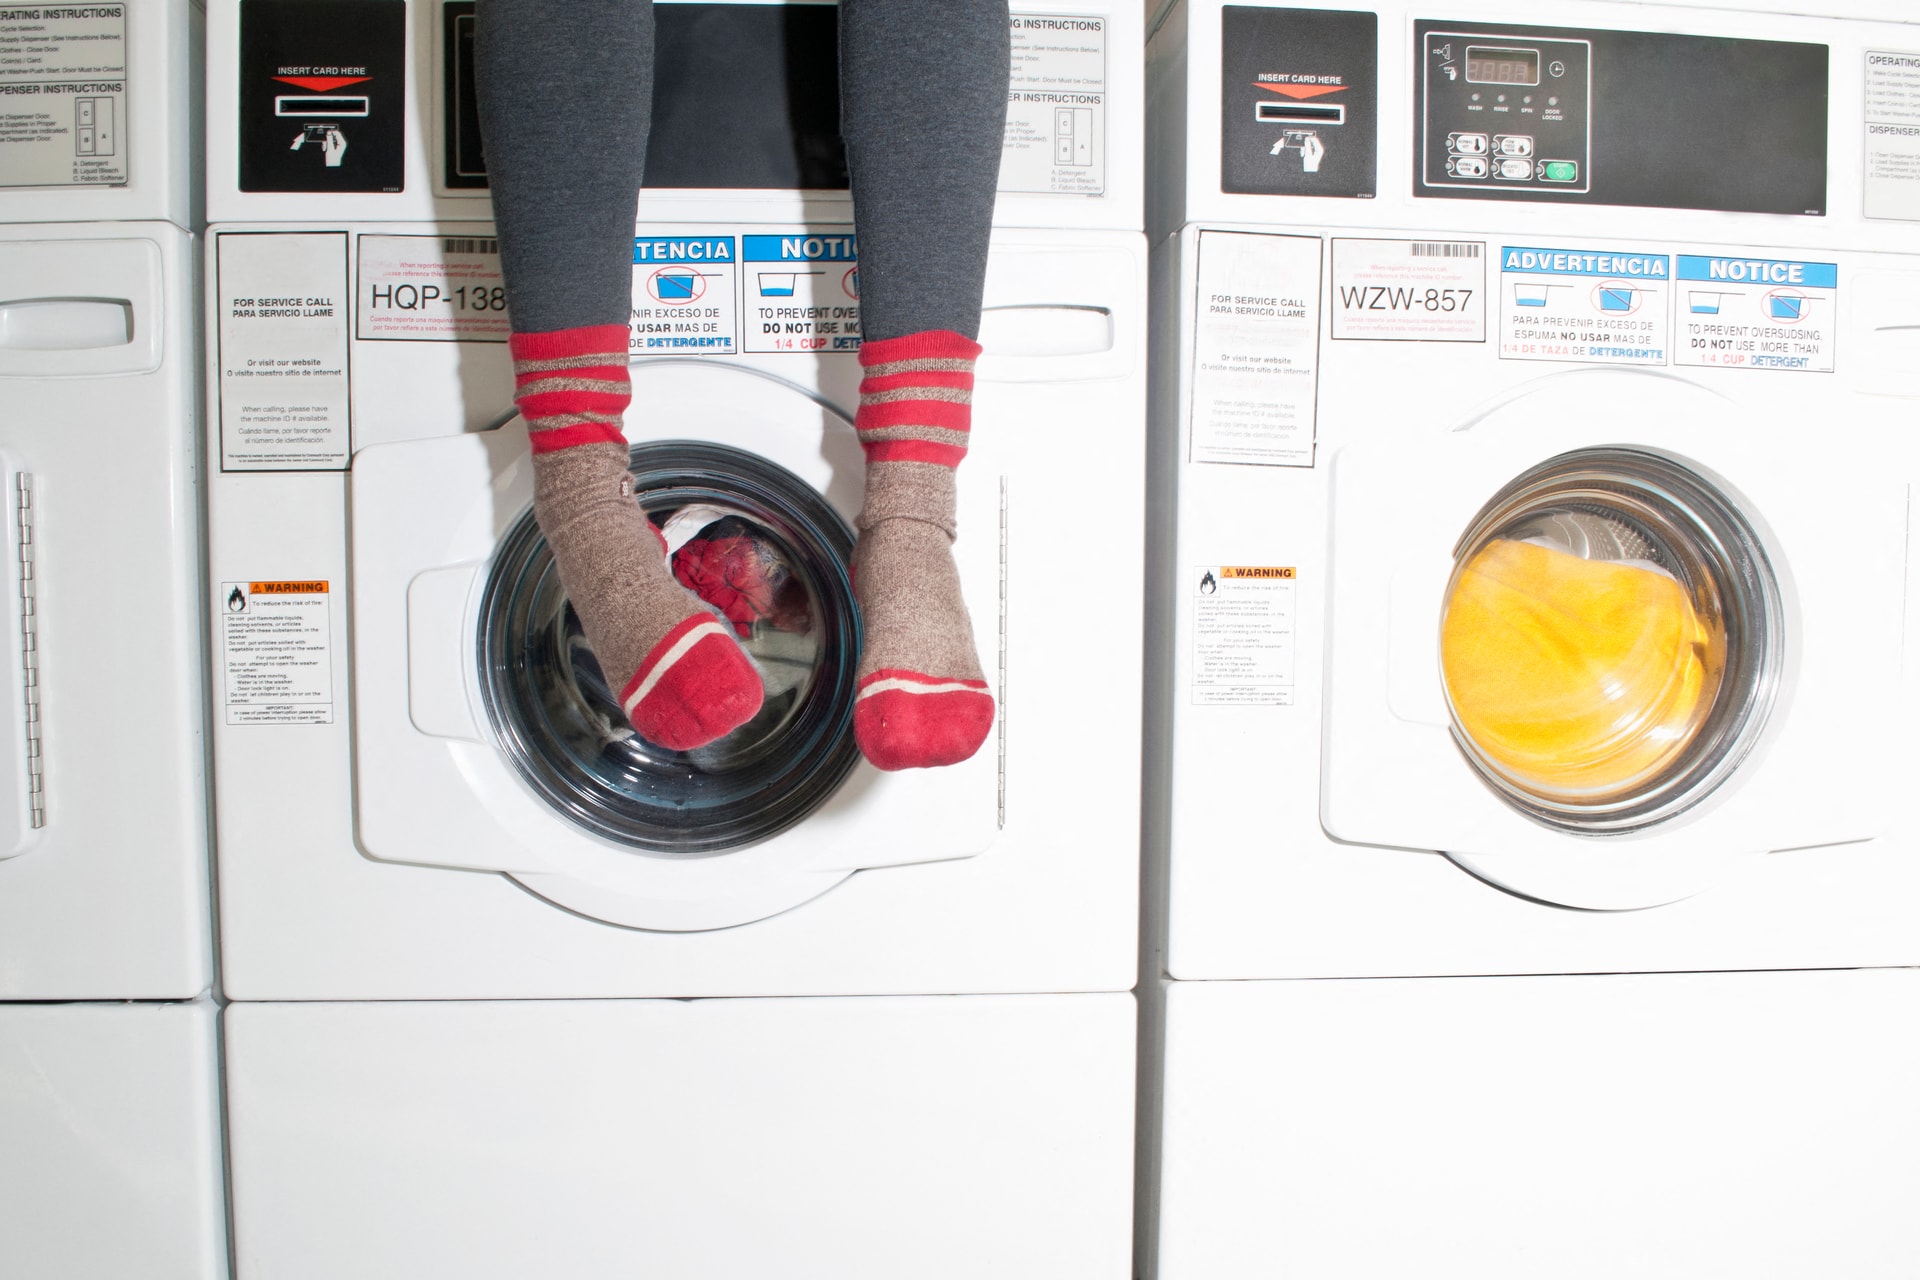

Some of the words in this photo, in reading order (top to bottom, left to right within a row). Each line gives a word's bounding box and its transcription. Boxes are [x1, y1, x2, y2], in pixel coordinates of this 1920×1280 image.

[0, 10, 40, 20] RATING
[43, 8, 122, 18] INSTRUCTIONS
[1024, 19, 1101, 31] INSTRUCTIONS
[1869, 56, 1920, 67] OPERATING
[278, 67, 310, 75] INSERT
[312, 67, 339, 75] CARD
[341, 67, 366, 75] HERE
[1258, 74, 1289, 82] INSERT
[1292, 75, 1316, 83] CARD
[1318, 76, 1342, 84] HERE
[0, 86, 40, 95] PENSER
[44, 84, 122, 94] INSTRUCTIONS
[1024, 94, 1100, 104] INSTRUCTIONS
[1869, 126, 1919, 136] DISPENSER
[636, 242, 729, 259] TENCIA
[782, 238, 858, 258] NOTI
[1506, 252, 1664, 276] ADVERTENCIA
[1710, 260, 1802, 283] NOTICE
[234, 299, 254, 307] FOR
[258, 298, 303, 307] SERVICE
[372, 284, 506, 310] HQP-138
[1211, 295, 1231, 303] FOR
[1235, 296, 1278, 306] SERVICE
[1281, 299, 1306, 308] CALL
[1340, 286, 1472, 312] WZW-857
[656, 308, 701, 318] EXCESO
[705, 308, 720, 318] DE
[759, 308, 773, 318] TO
[777, 308, 830, 318] PREVENT
[1210, 306, 1232, 314] PARA
[1235, 307, 1274, 316] SERVICIO
[1277, 309, 1306, 318] LLAME
[637, 324, 671, 332] USAR
[675, 323, 699, 332] MAS
[703, 323, 718, 332] DE
[763, 323, 780, 334] DO
[786, 323, 811, 334] NOT
[815, 323, 838, 333] USE
[844, 323, 860, 333] MO
[1513, 316, 1539, 325] PARA
[1543, 318, 1593, 328] PREVENIR
[1597, 320, 1637, 330] EXCESO
[1641, 322, 1653, 331] DE
[1688, 324, 1700, 334] TO
[1704, 325, 1749, 336] PREVENT
[629, 339, 644, 348] DE
[647, 337, 731, 348] DETERGENTE
[1515, 330, 1556, 340] ESPUMA
[1560, 332, 1576, 341] NO
[1580, 333, 1610, 343] USAR
[1614, 334, 1635, 344] MAS
[1638, 336, 1651, 345] DE
[775, 339, 793, 350] 1/4
[800, 338, 828, 349] CUP
[1691, 339, 1706, 349] DO
[1710, 340, 1733, 350] NOT
[1736, 341, 1755, 351] USE
[1761, 342, 1788, 353] MORE
[1794, 344, 1819, 354] THAN
[1503, 344, 1518, 353] 1/4
[1522, 345, 1536, 353] DE
[1541, 345, 1569, 355] TAZA
[1572, 347, 1585, 355] DE
[1590, 347, 1663, 359] DETERGENTE
[1723, 354, 1745, 364] CUP
[1751, 355, 1809, 368] DETERGENT
[1236, 568, 1292, 577] WARNING
[264, 583, 323, 592] WARNING
